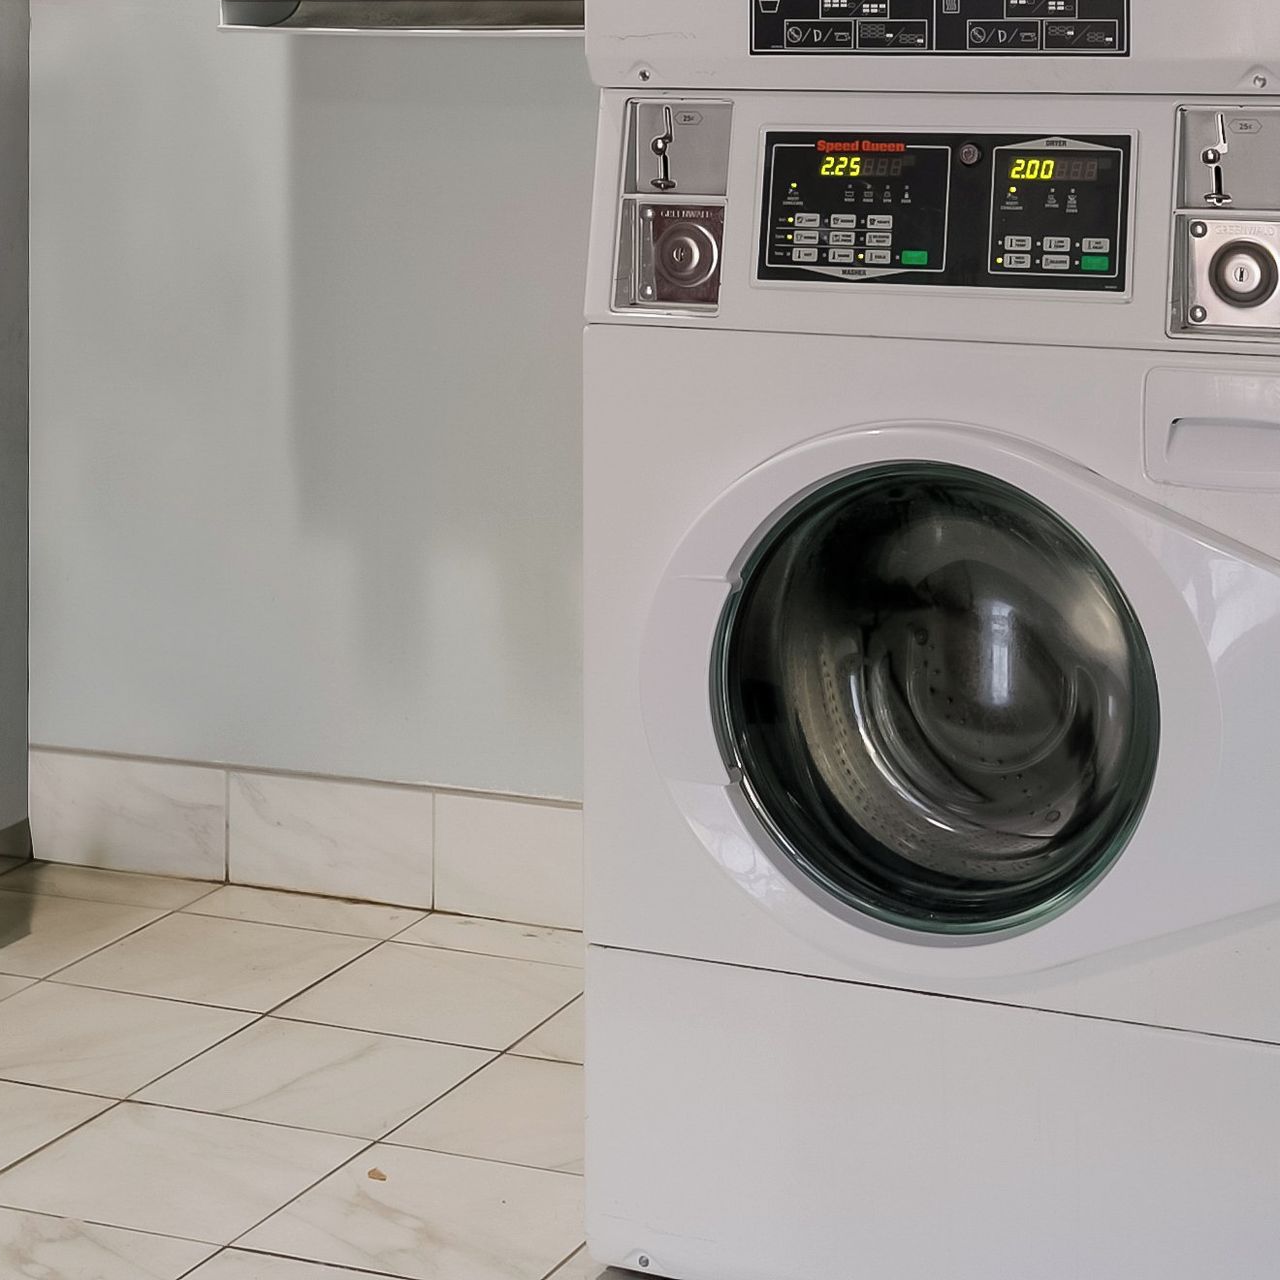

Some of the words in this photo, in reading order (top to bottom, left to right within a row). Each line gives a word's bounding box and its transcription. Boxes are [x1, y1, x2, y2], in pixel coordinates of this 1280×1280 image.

[816, 140, 860, 153] Speed
[862, 140, 906, 152] Queen
[821, 156, 861, 176] 2.25
[1010, 159, 1055, 179] 2.00
[1214, 224, 1276, 236] GREENWALD
